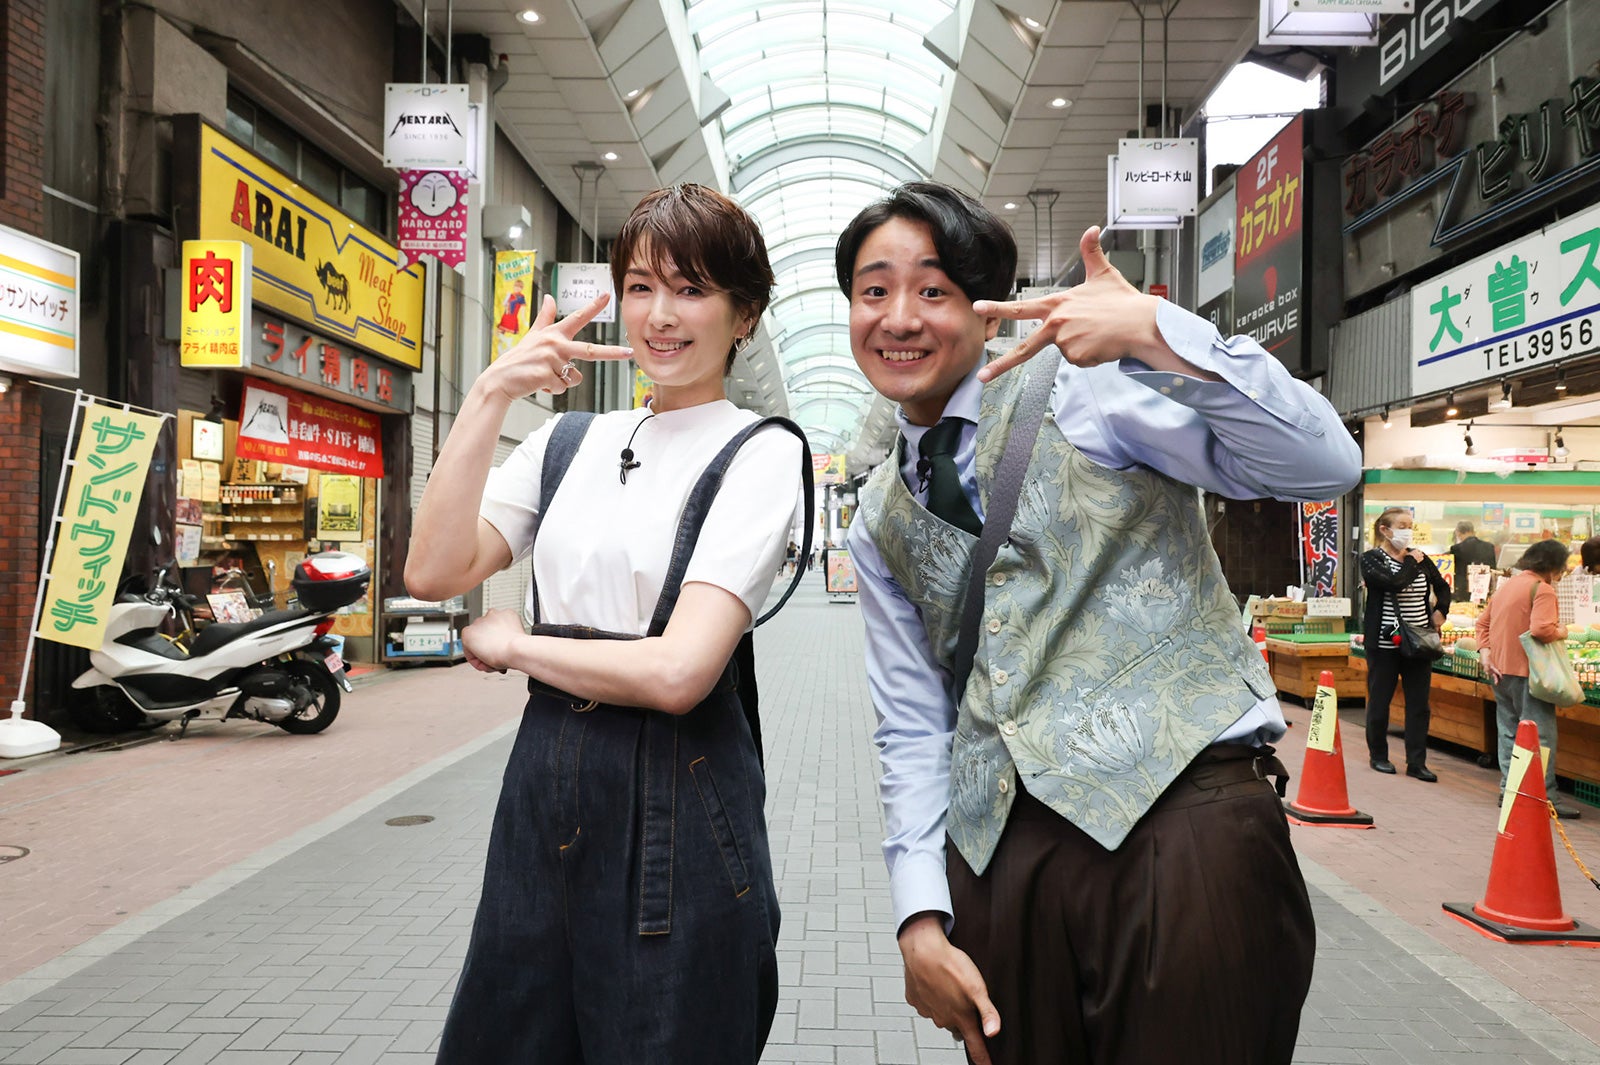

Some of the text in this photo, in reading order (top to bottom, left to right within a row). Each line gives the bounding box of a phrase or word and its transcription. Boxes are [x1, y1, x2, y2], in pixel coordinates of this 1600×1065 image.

[1125, 170, 1192, 183] ハッピーロード大山
[1256, 145, 1279, 190] 2F
[231, 179, 307, 261] ARAI
[401, 219, 463, 229] HARO CARD
[1241, 172, 1299, 258] カラオケ
[189, 250, 233, 314] 肉
[358, 252, 394, 297] Meat
[372, 296, 407, 343] Shop
[1236, 287, 1298, 329] karaoke box
[183, 342, 239, 355] アライ精肉店
[252, 321, 393, 402] ライ精肉店
[51, 415, 146, 633] サンドウィッチ
